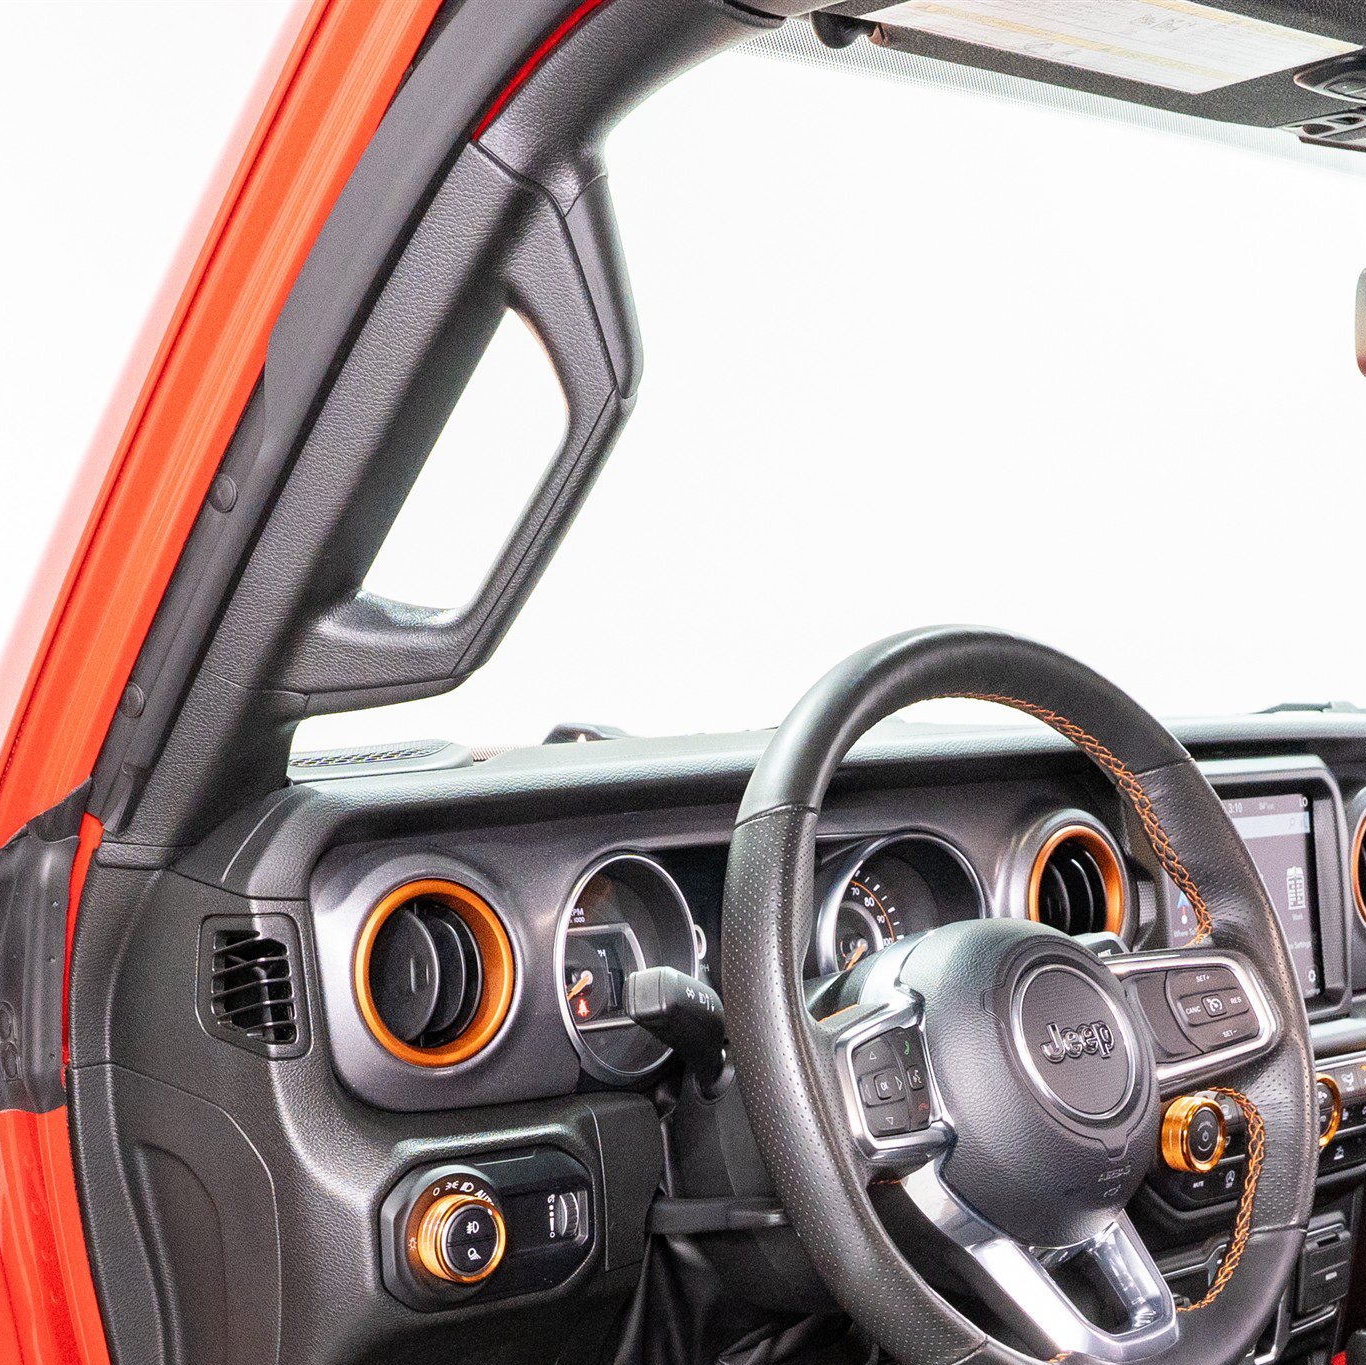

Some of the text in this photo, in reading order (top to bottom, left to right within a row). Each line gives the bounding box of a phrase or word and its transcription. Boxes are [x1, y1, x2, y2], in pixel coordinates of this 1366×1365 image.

[851, 887, 860, 895] 70
[864, 897, 875, 907] 80
[876, 915, 885, 923] 90
[1196, 974, 1210, 983] SET+
[1229, 996, 1242, 1005] RES
[1185, 1005, 1202, 1015] CANC
[1040, 1020, 1115, 1063] Jeep
